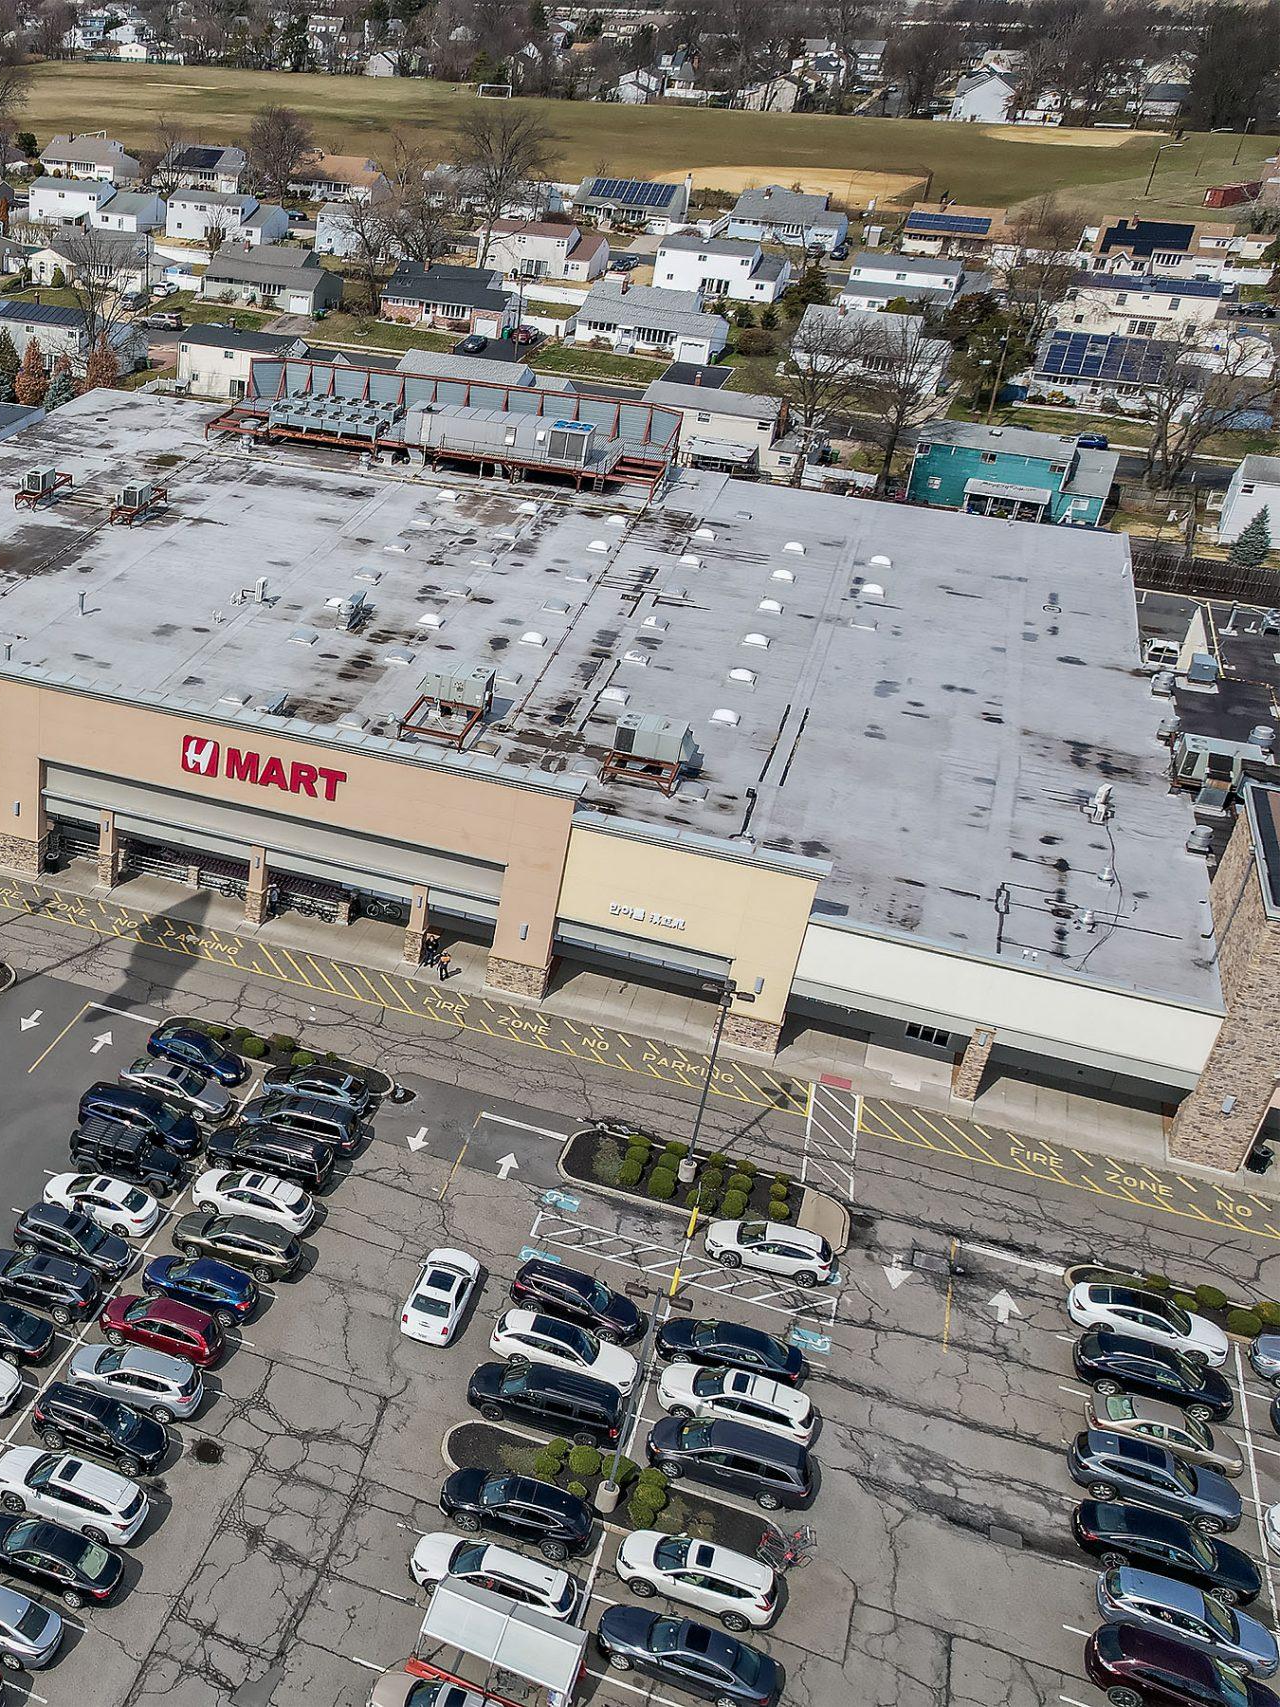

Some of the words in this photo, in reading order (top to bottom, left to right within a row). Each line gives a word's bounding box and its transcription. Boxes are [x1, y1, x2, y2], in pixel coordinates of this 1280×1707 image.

[225, 747, 348, 802] MART
[45, 899, 92, 917] ZONE
[112, 916, 139, 930] NO
[163, 930, 240, 956] PARKING
[423, 996, 469, 1016] FIRE
[496, 1015, 552, 1037] ZONE
[581, 1036, 610, 1052] NO
[1009, 1146, 1064, 1170] FIRE
[1104, 1170, 1174, 1199] ZONE
[1216, 1199, 1254, 1218] NO
